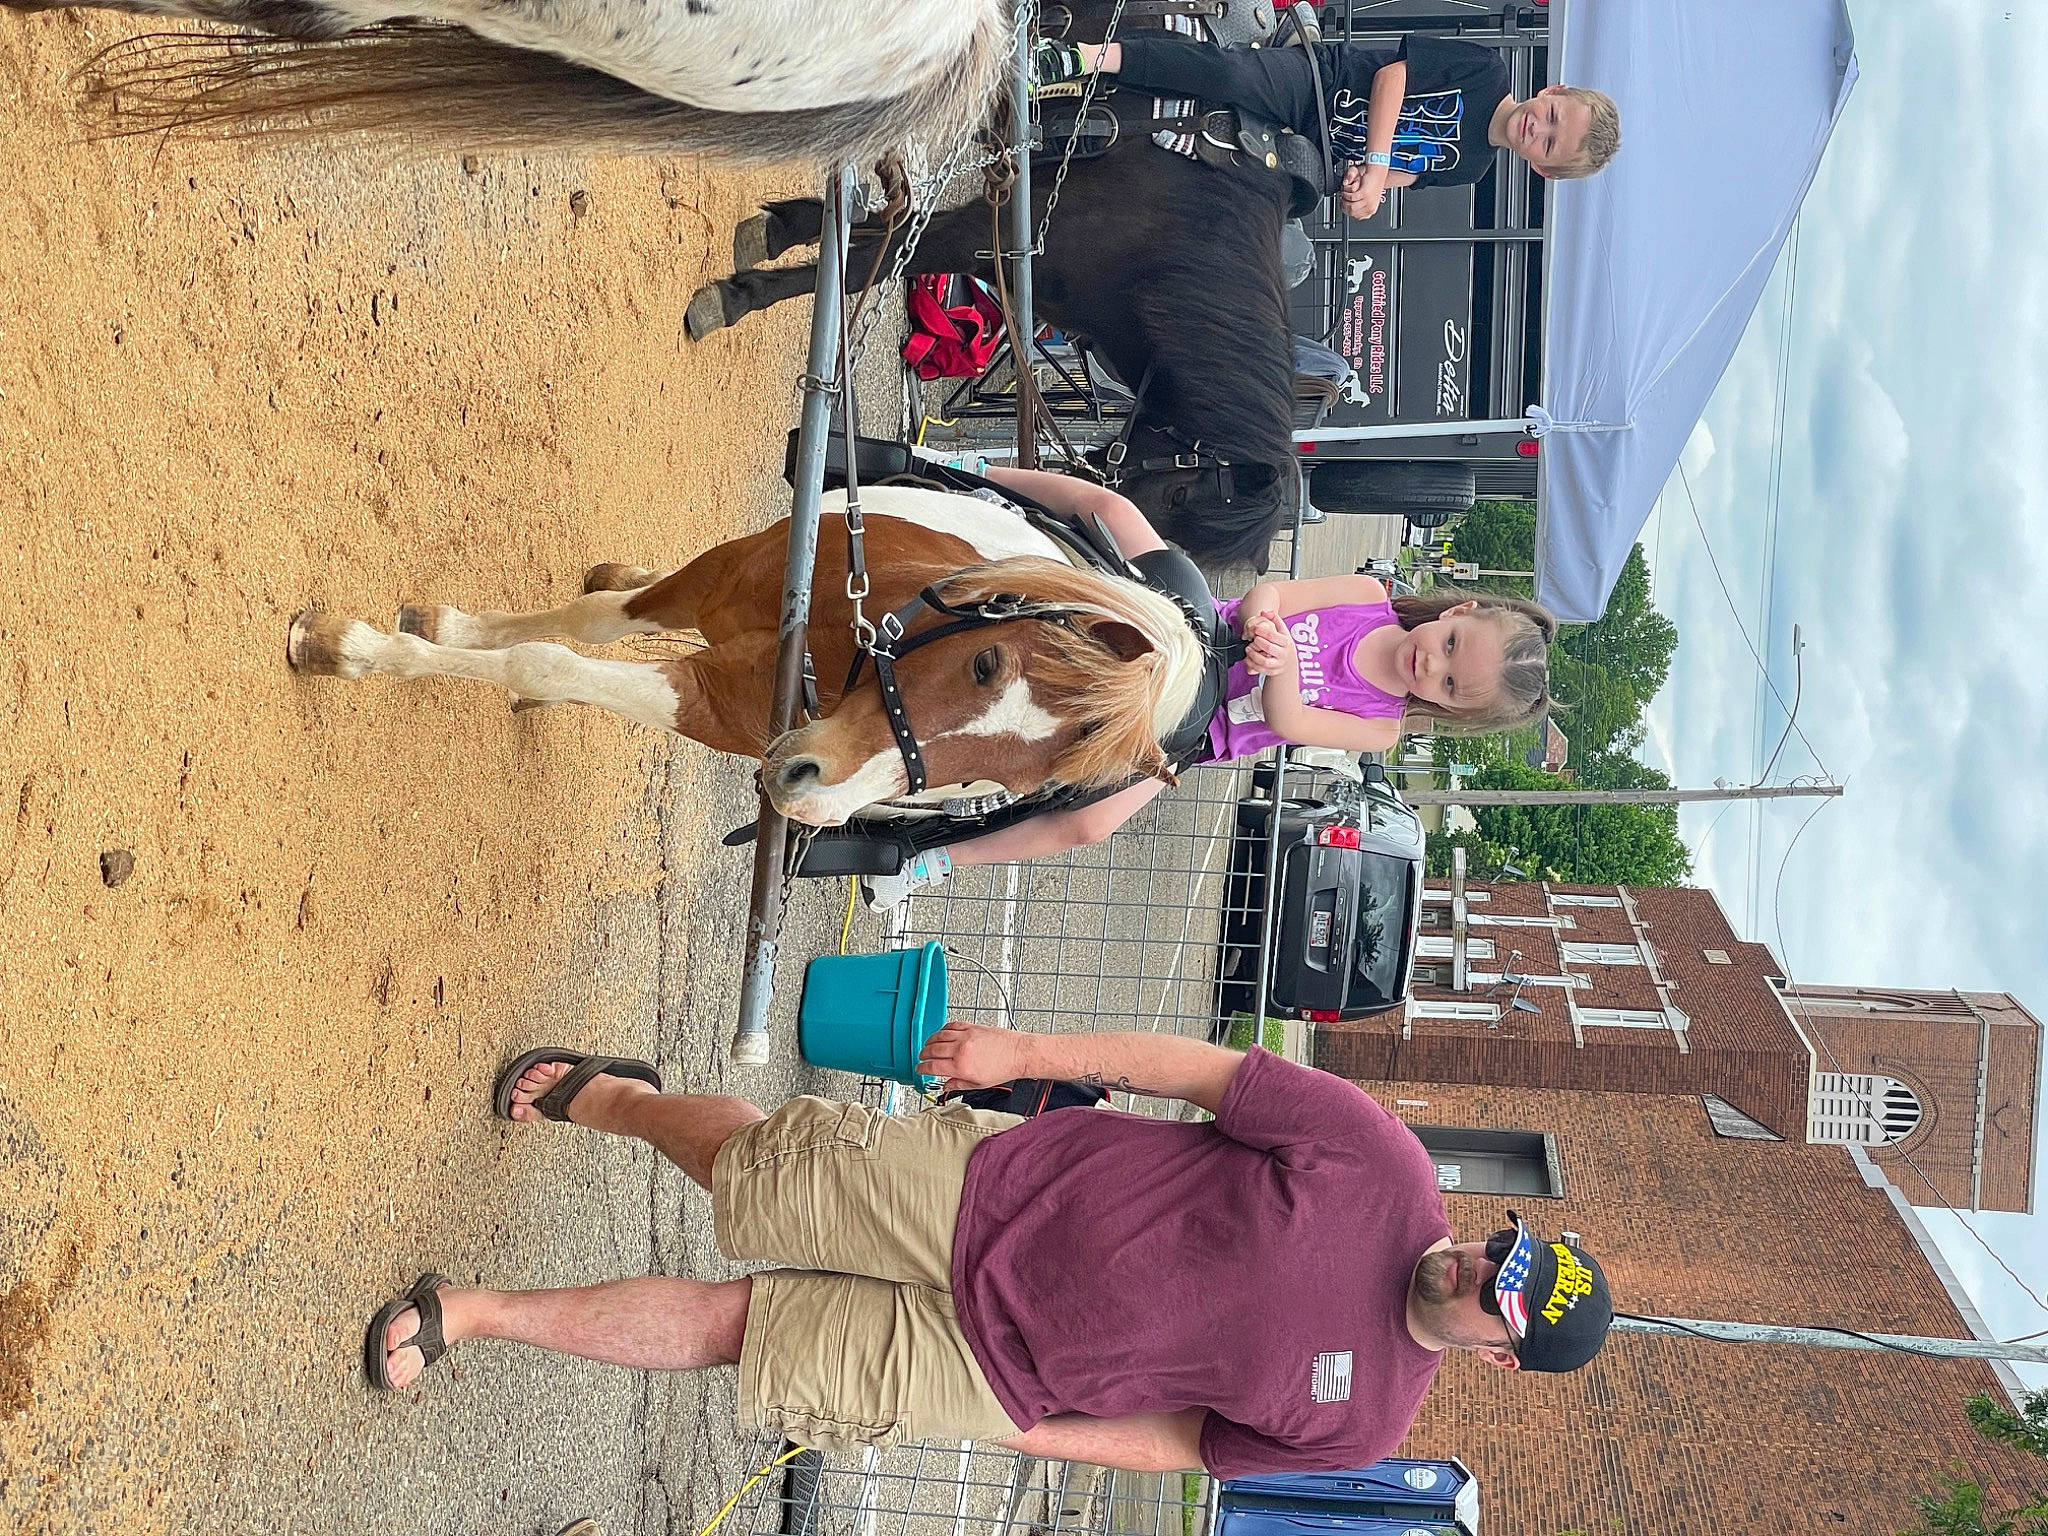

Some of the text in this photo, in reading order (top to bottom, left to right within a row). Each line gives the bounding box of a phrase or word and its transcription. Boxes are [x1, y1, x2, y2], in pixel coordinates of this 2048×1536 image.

[1353, 295, 1364, 318] Upper
[1368, 271, 1386, 394] Gottfried Pony Rides LLC
[1444, 319, 1465, 416] Delta
[1541, 1243, 1576, 1325] VETERAN
[1573, 1266, 1593, 1296] U.S.
